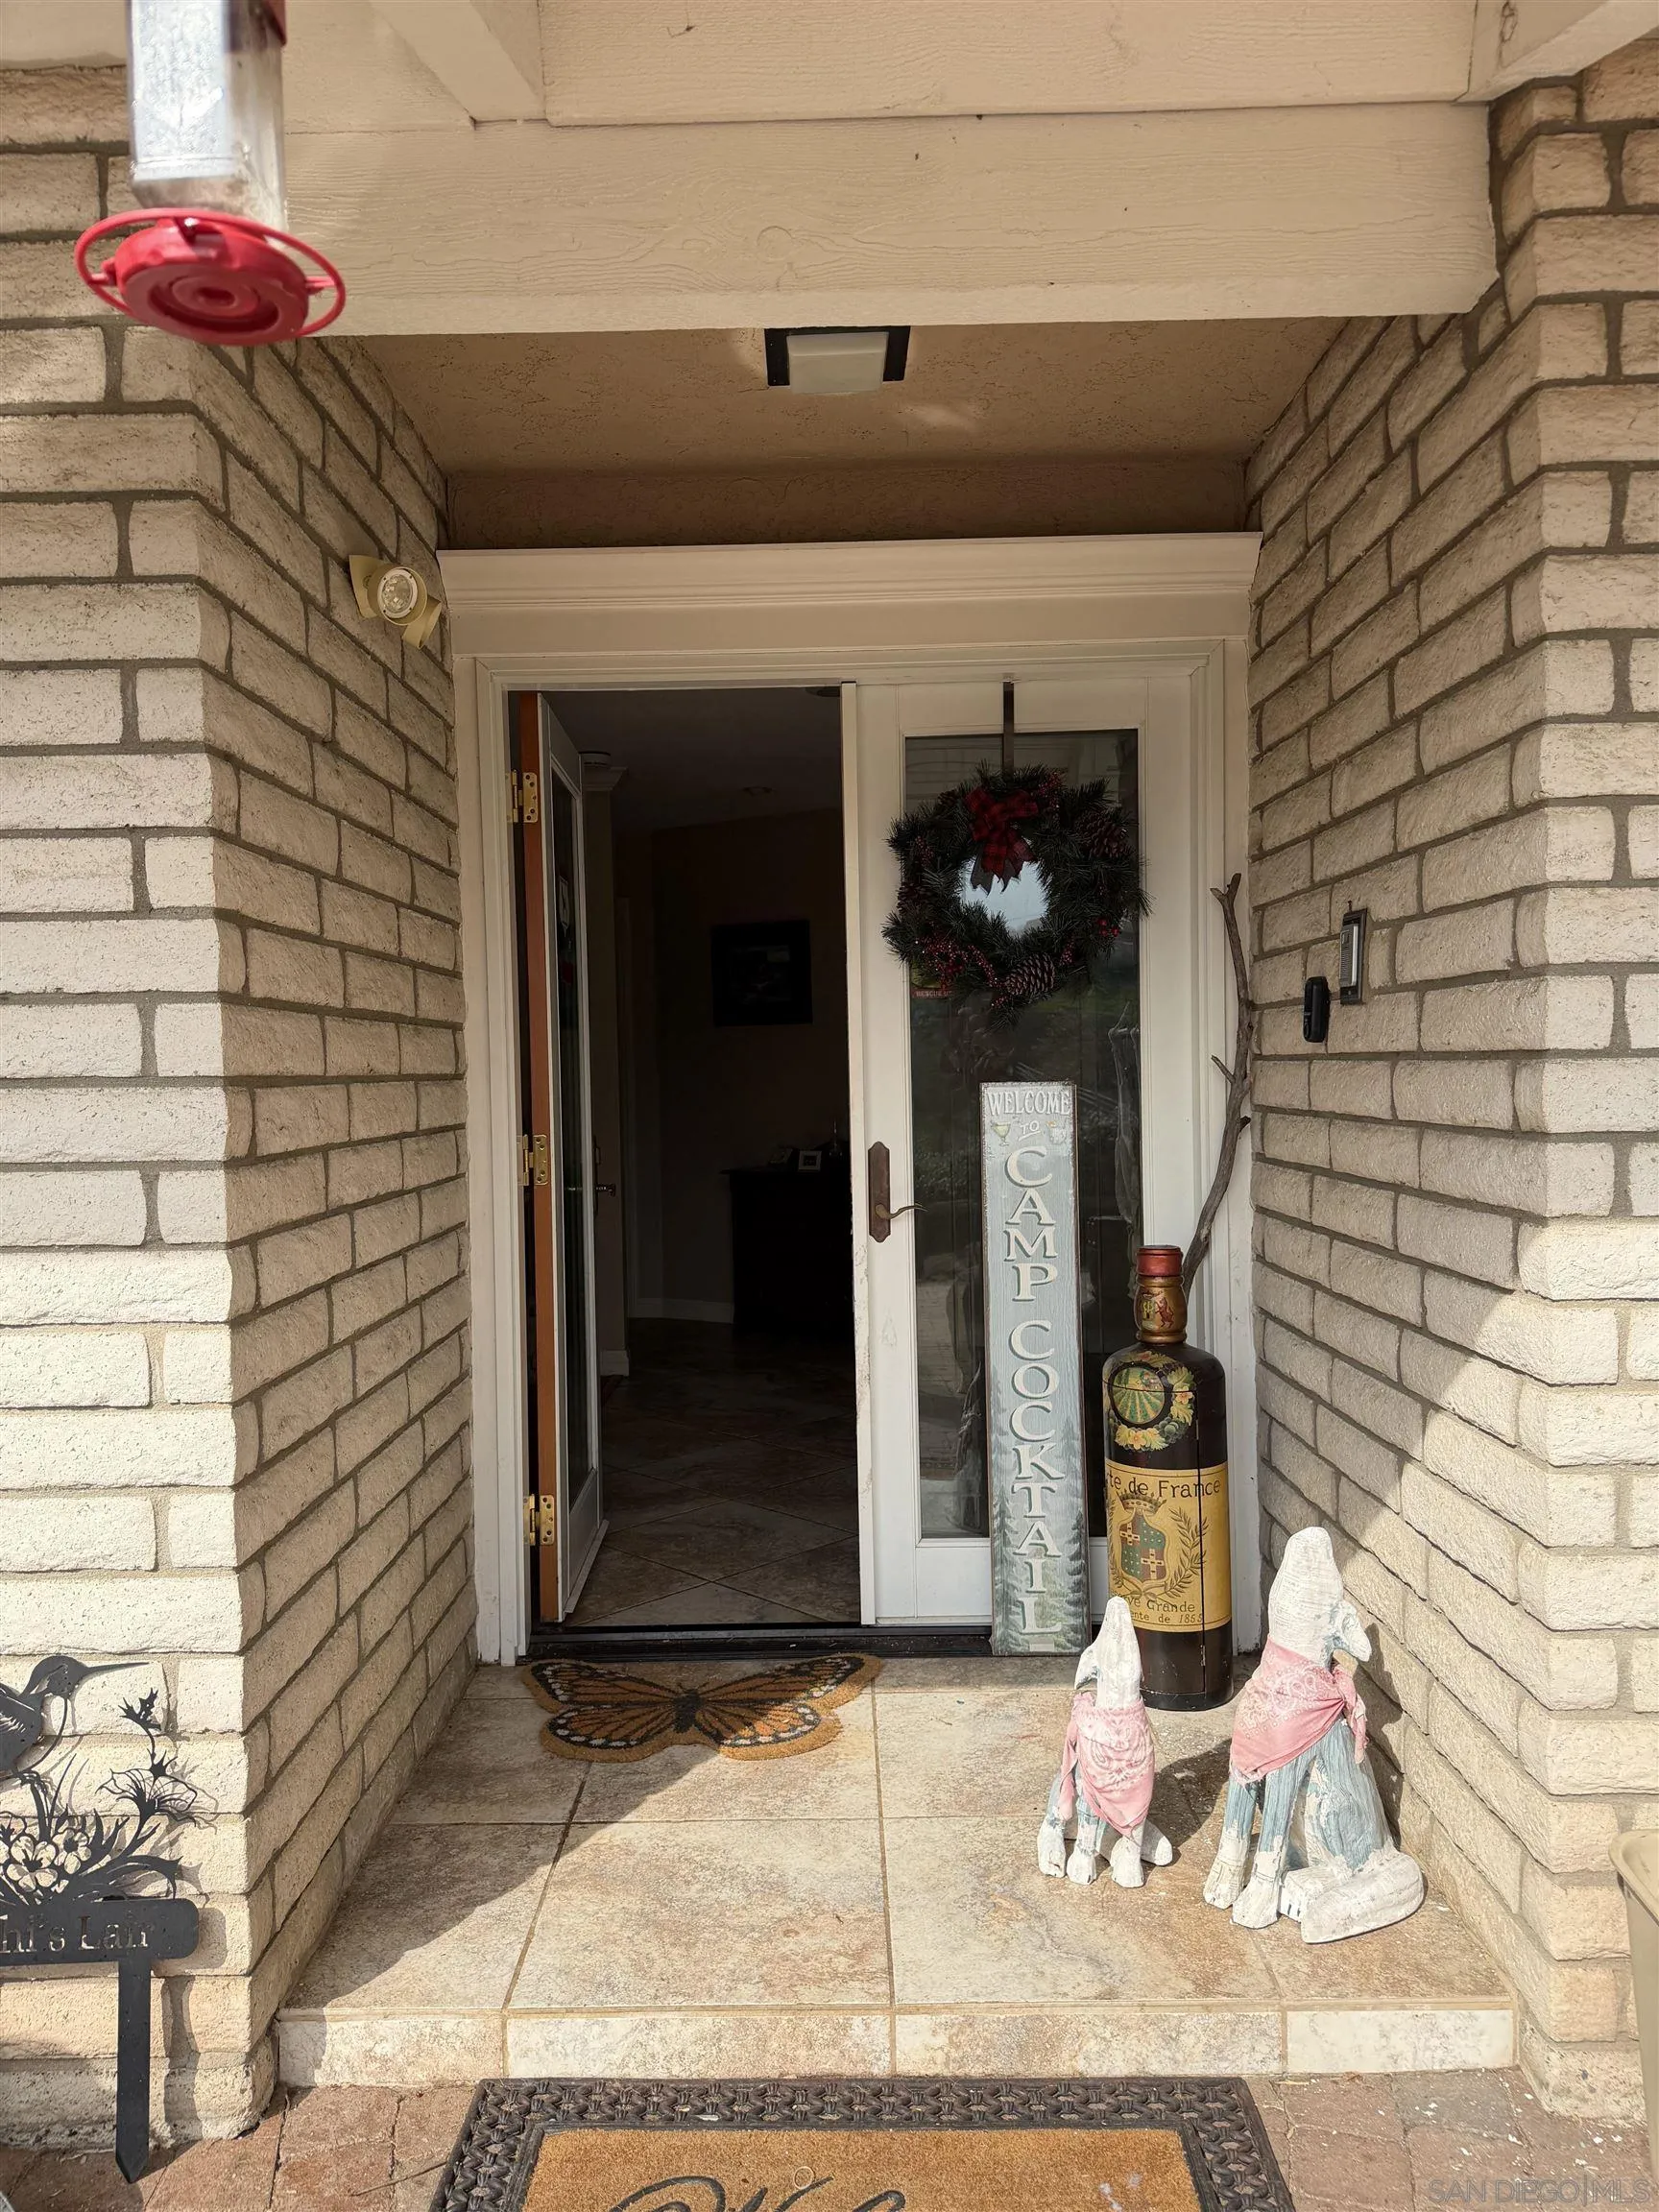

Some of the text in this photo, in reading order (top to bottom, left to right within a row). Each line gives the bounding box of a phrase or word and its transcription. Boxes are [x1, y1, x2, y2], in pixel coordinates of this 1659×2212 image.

[987, 1089, 1071, 1117] WELCOME
[1021, 1120, 1041, 1135] TO
[1004, 1146, 1066, 1635] CAMP COCKTAIL
[1128, 1477, 1149, 1496] de
[1158, 1479, 1221, 1499] France
[1146, 1599, 1195, 1613] Grande
[1158, 1613, 1170, 1623] de
[78, 1914, 156, 1950] Lair
